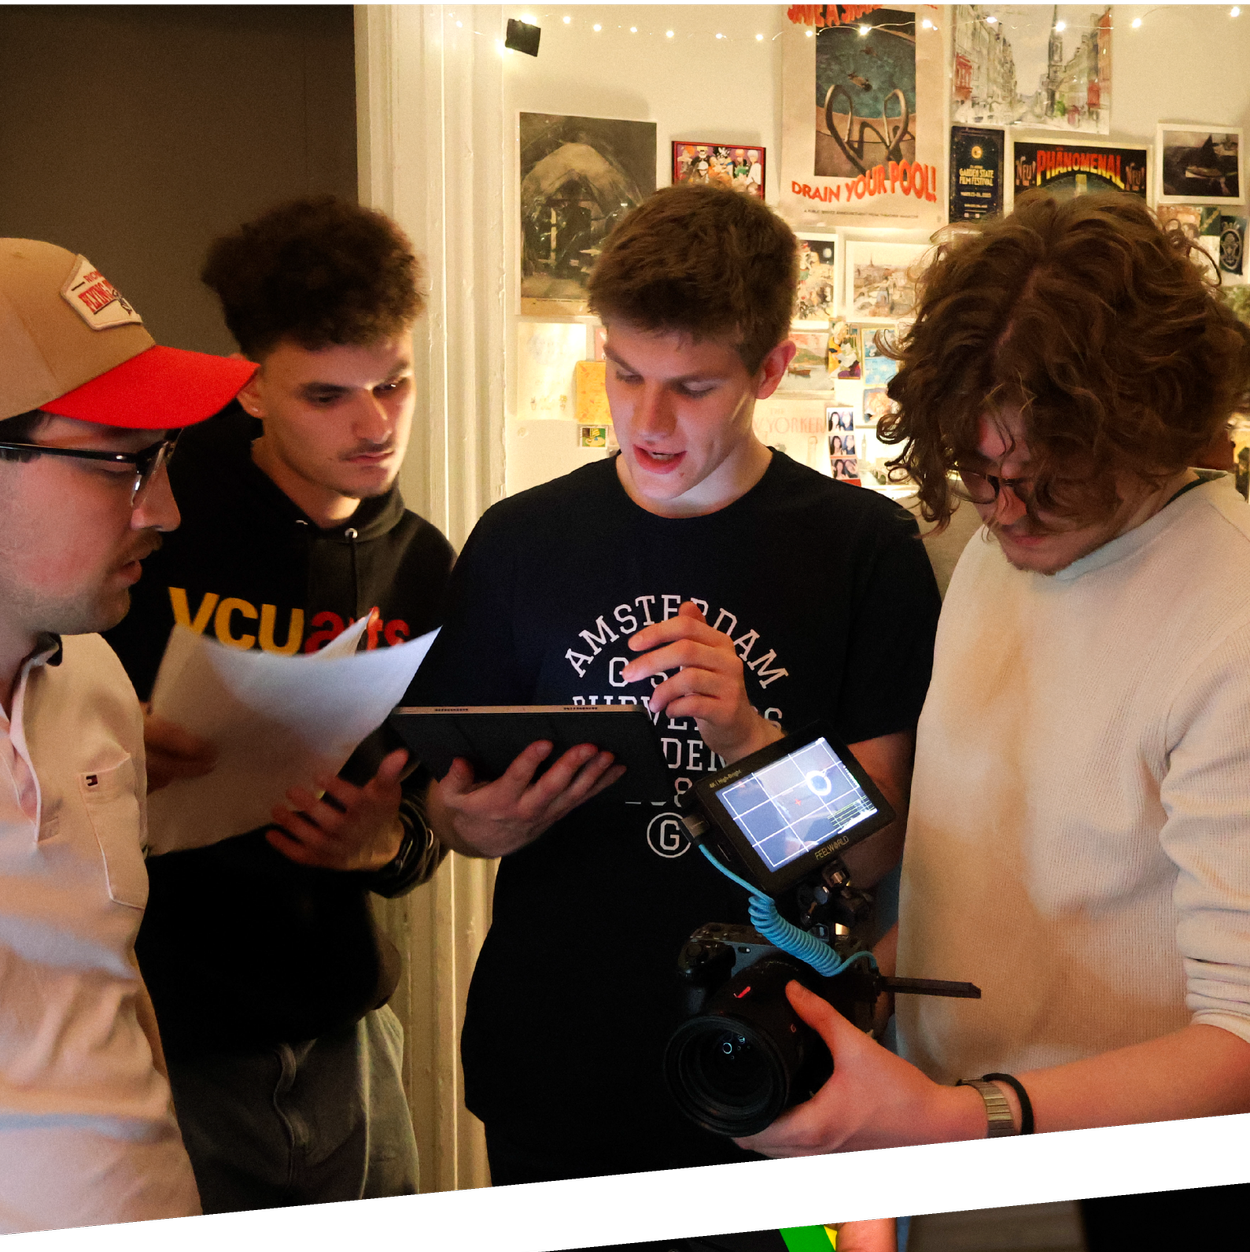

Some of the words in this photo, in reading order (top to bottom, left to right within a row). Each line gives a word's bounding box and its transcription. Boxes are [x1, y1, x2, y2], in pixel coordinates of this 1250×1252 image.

[791, 180, 840, 203] DRAIN
[844, 164, 887, 202] YOUR
[888, 159, 937, 203] POOL!
[168, 586, 410, 658] VCUats
